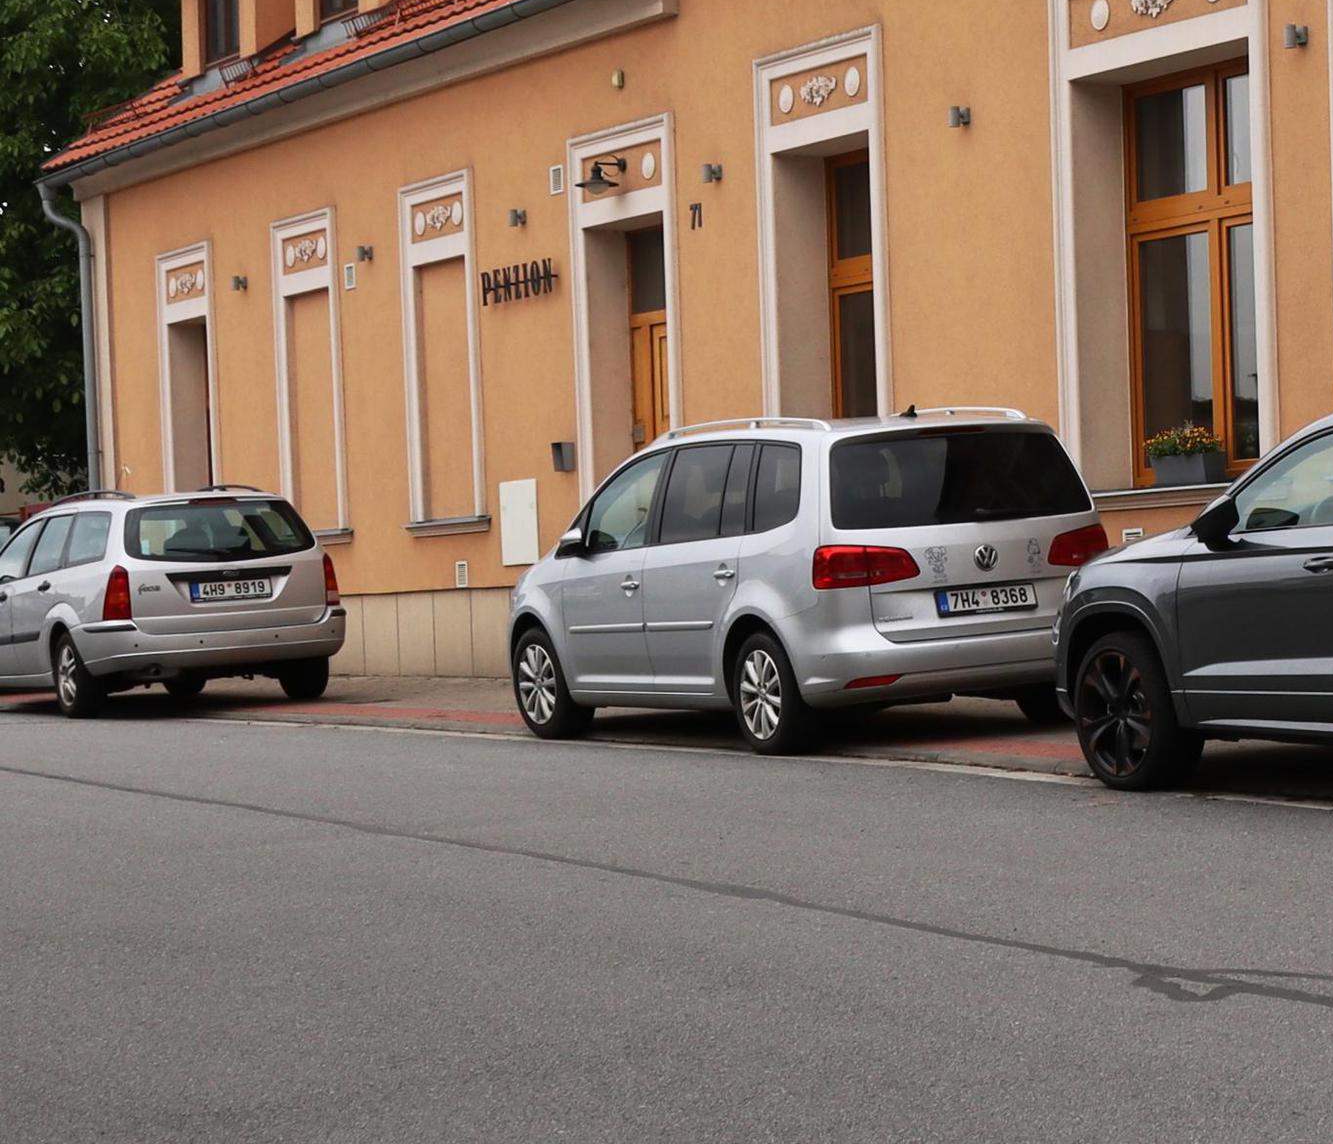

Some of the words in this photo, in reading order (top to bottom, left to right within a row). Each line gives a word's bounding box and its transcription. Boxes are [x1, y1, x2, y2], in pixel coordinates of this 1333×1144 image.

[689, 202, 702, 231] 71
[480, 257, 553, 307] PENZION
[202, 583, 226, 596] 4H9
[235, 581, 265, 594] 8919
[950, 592, 980, 609] 7H4
[991, 587, 1028, 605] 8368
